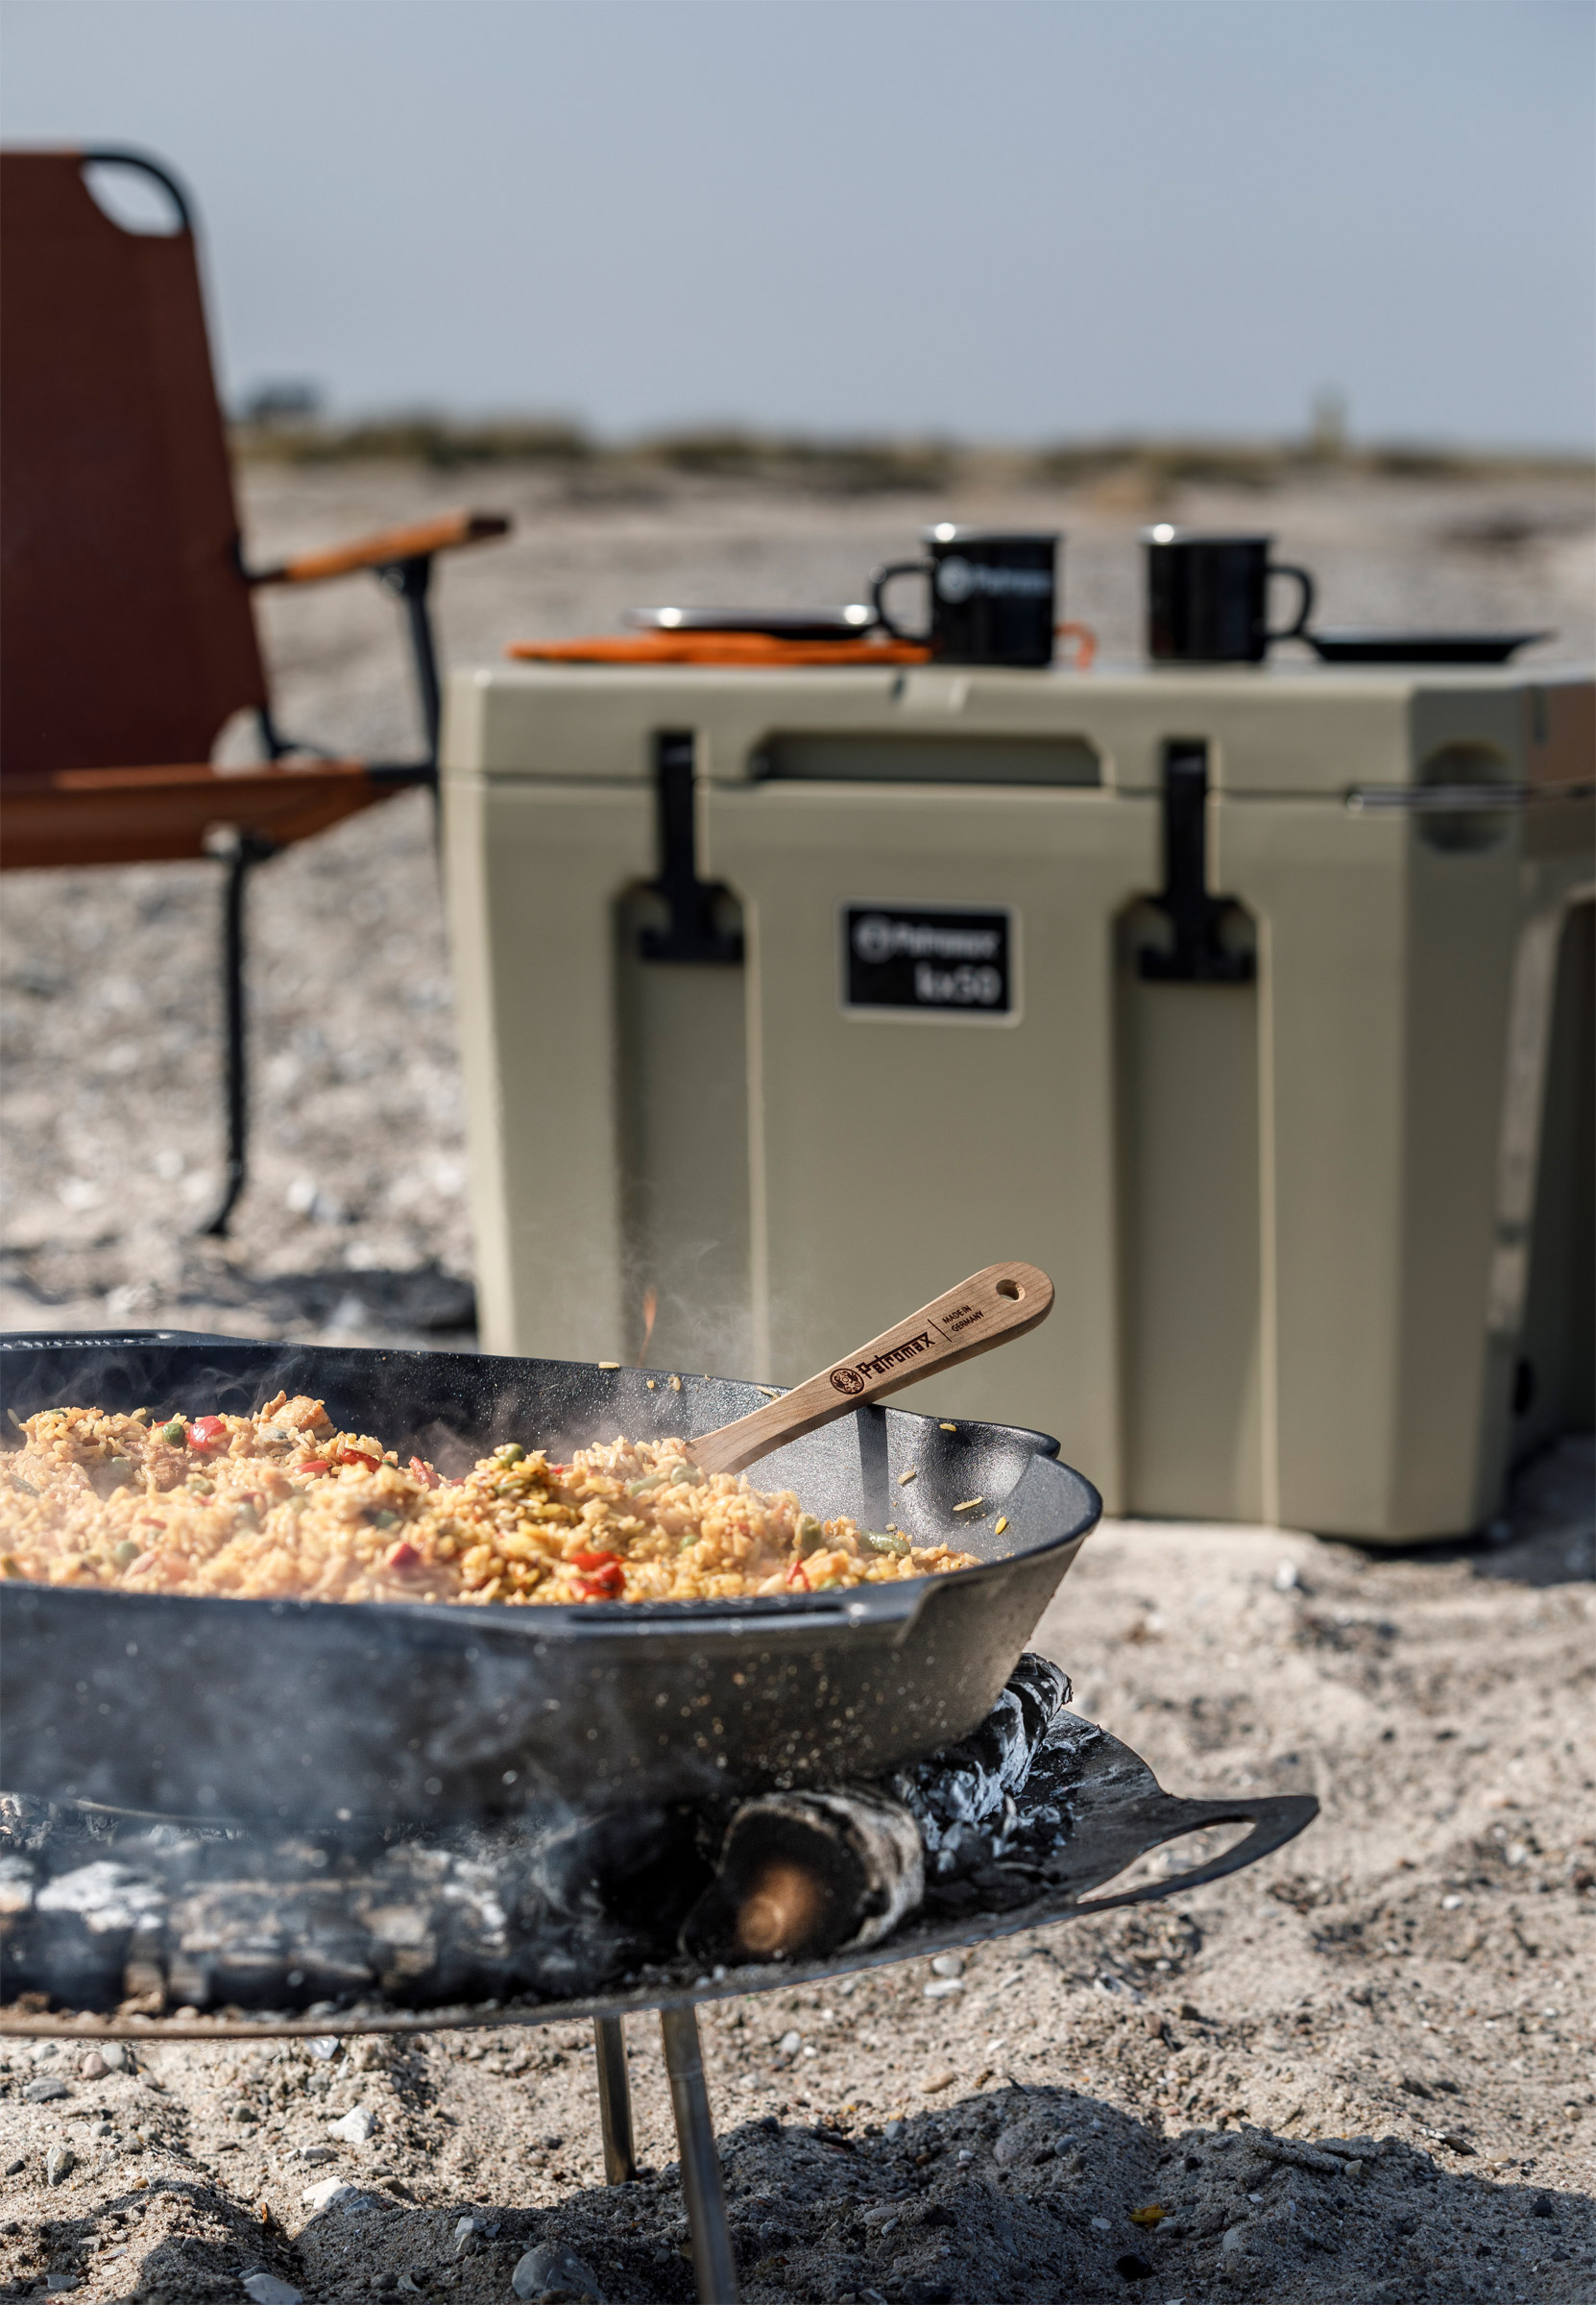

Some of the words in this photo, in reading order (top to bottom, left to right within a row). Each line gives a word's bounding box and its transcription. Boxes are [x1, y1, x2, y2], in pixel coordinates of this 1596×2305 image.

[942, 1309, 964, 1323] MADE
[961, 1305, 972, 1314] IN
[952, 1310, 984, 1332] GERMANY
[856, 1331, 935, 1379] Petromax
